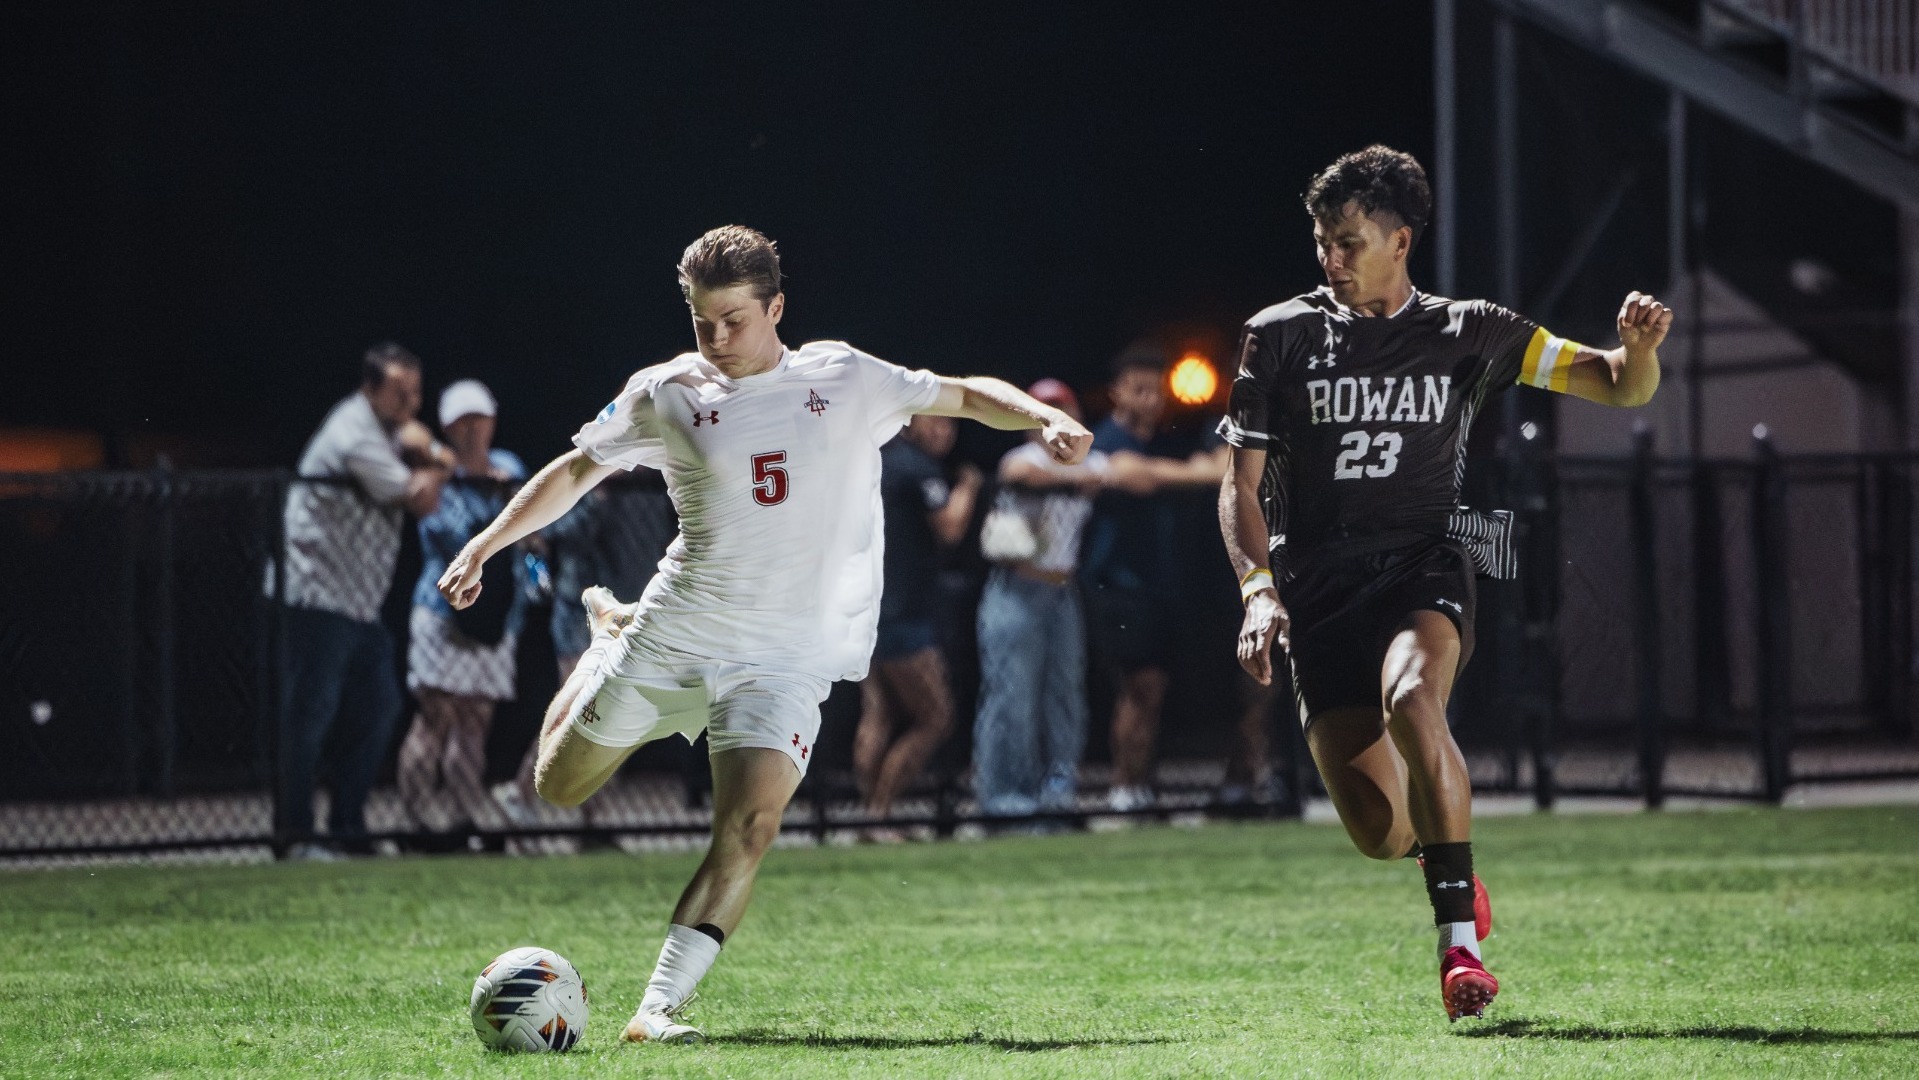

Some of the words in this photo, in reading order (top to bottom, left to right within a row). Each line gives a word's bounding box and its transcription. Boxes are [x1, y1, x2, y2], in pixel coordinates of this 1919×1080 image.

[1307, 375, 1451, 424] ROWAN
[751, 450, 789, 506] 5
[1334, 430, 1403, 480] 23
